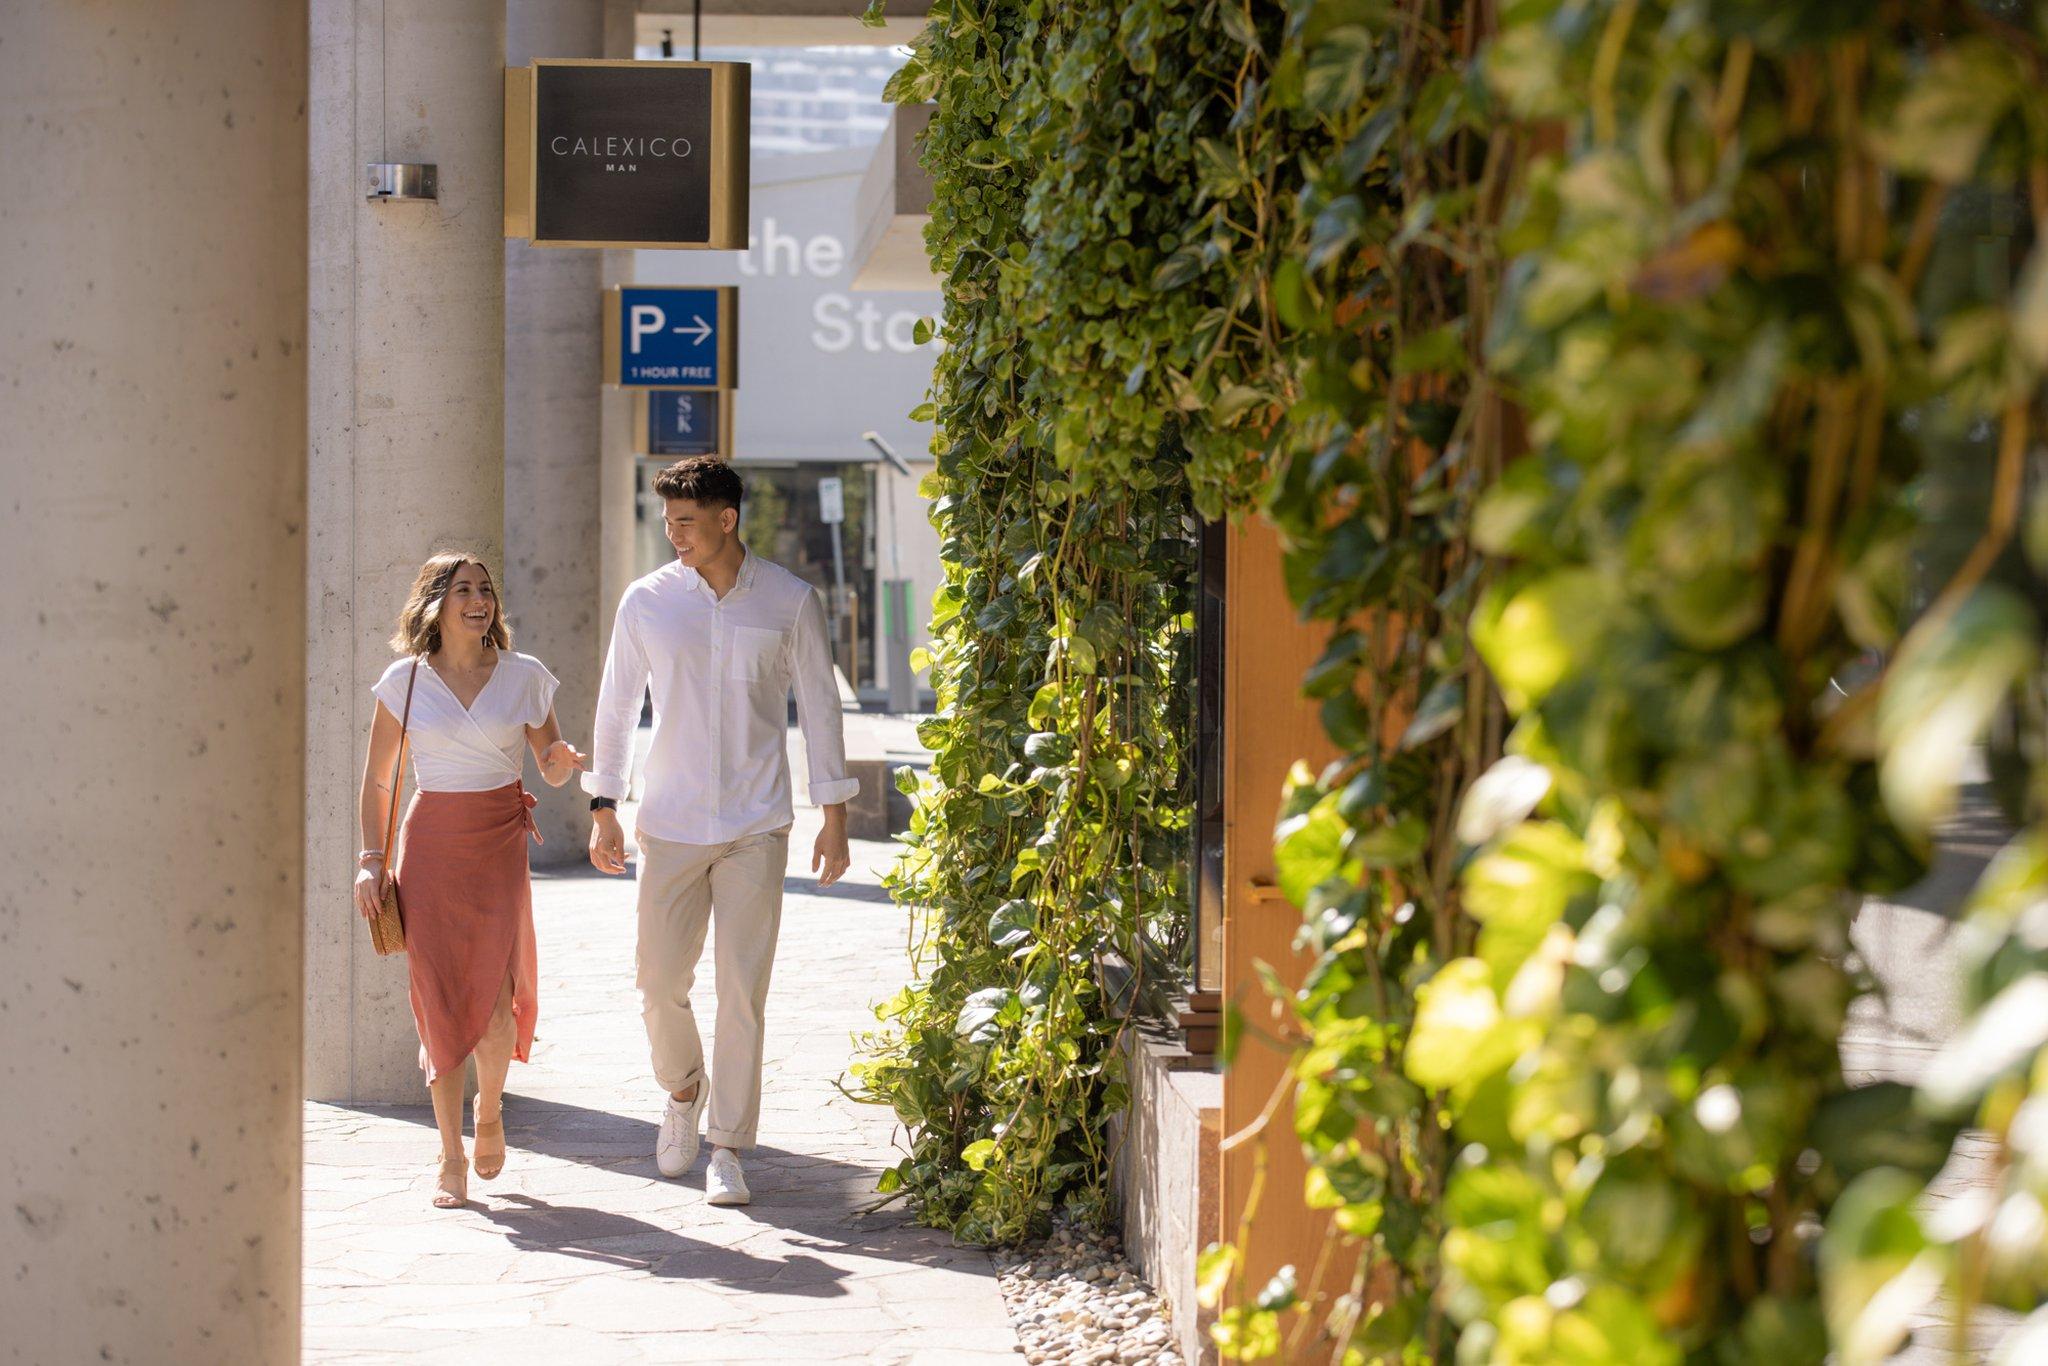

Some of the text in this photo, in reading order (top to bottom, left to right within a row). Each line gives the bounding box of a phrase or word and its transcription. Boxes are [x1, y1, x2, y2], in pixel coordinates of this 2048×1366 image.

[551, 136, 692, 157] CALEXICO
[606, 164, 637, 172] MAN
[630, 305, 666, 354] P
[631, 366, 712, 378] 1 HOUR FREE
